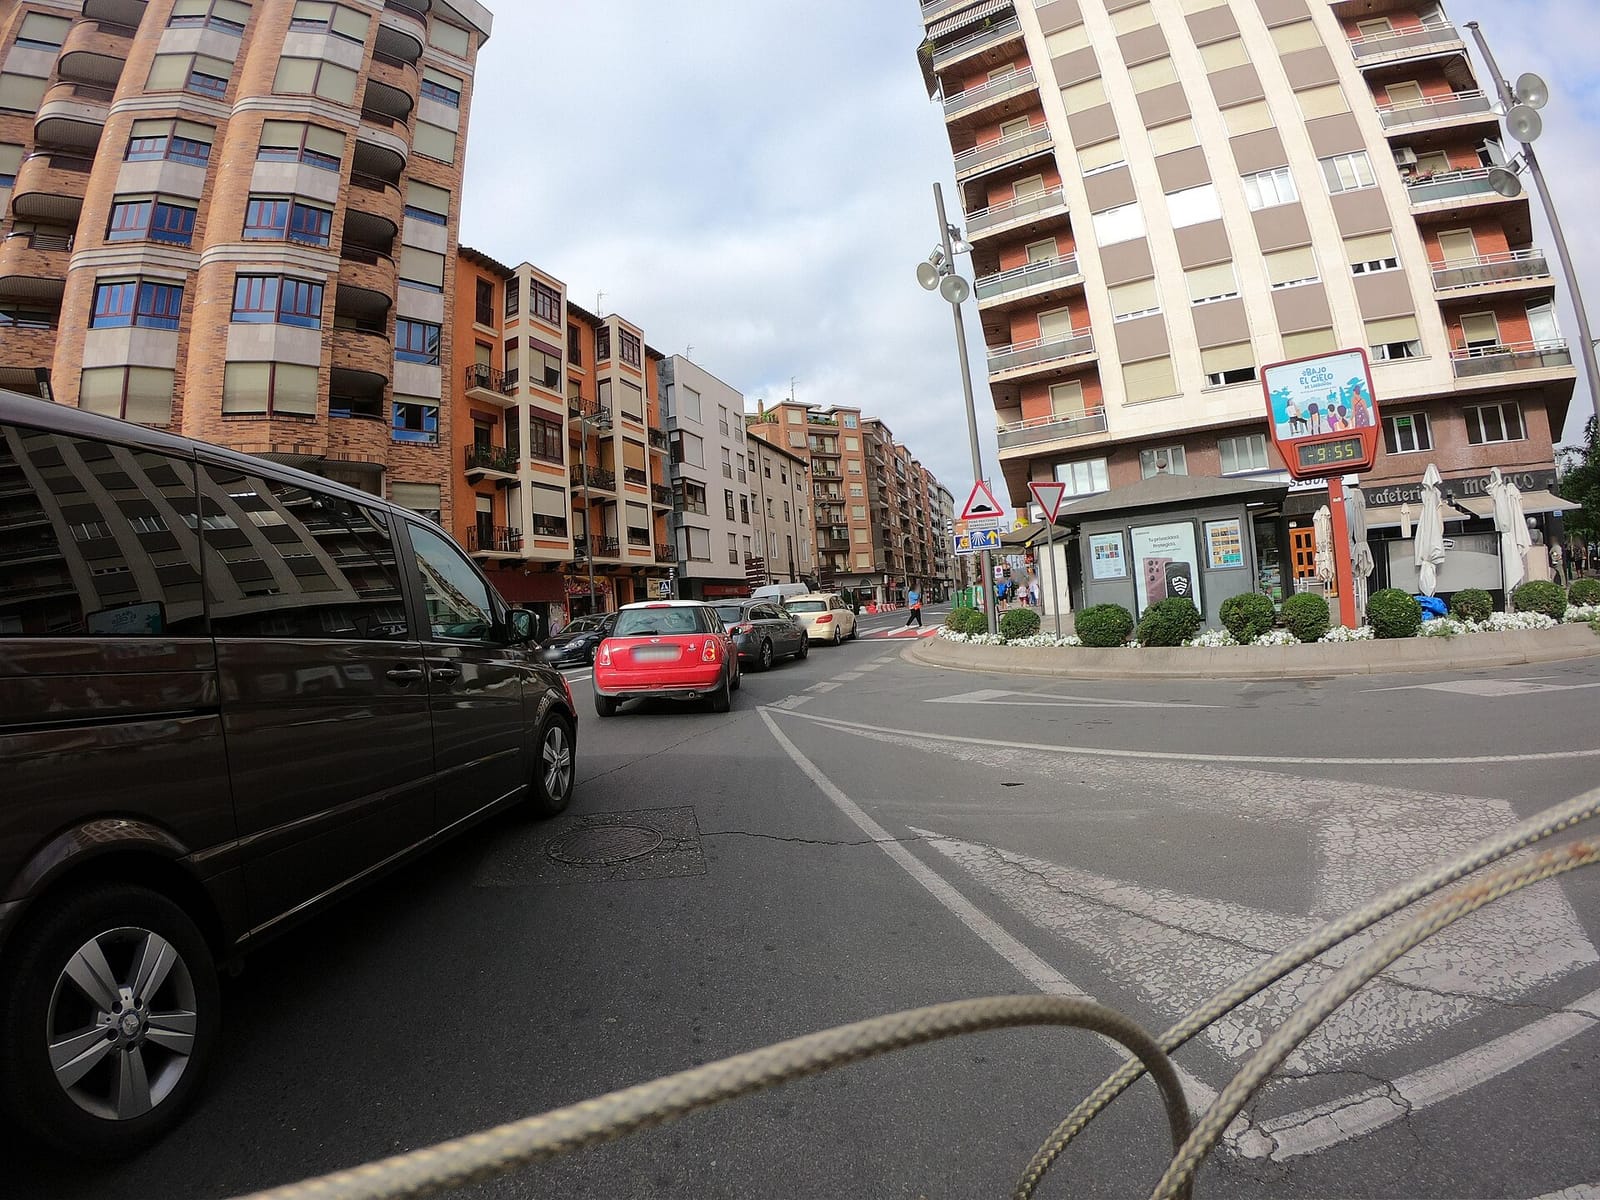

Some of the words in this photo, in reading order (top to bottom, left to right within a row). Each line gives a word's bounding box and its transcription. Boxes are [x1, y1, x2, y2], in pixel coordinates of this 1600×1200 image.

[1300, 377, 1309, 385] EL
[1369, 485, 1422, 505] cafeteri
[1462, 473, 1535, 495] moaco
